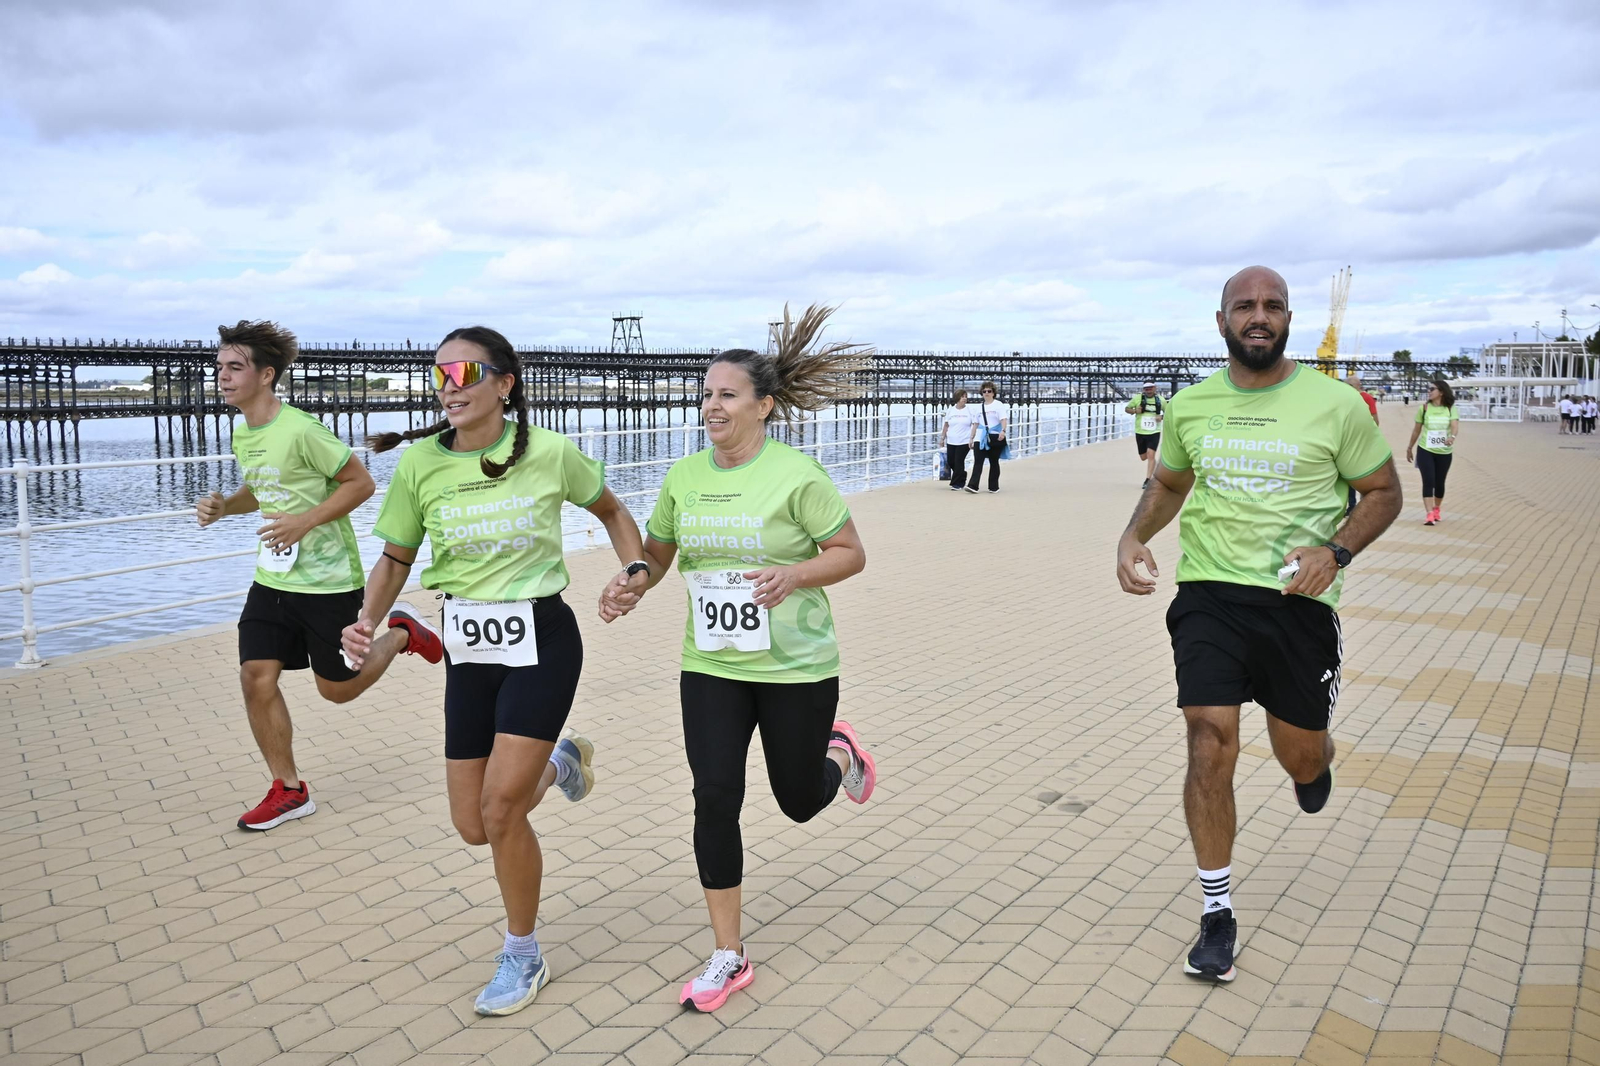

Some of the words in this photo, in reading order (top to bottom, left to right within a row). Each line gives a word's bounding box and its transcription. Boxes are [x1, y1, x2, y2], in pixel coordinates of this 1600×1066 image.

[1202, 434, 1224, 449] En
[1227, 438, 1300, 457] marcha
[1201, 454, 1271, 473] contra
[1273, 459, 1296, 476] el
[1206, 470, 1294, 493] cáncer
[441, 505, 462, 520] En
[466, 494, 535, 517] marcha
[443, 519, 513, 541] contra
[515, 511, 536, 530] el
[680, 511, 697, 527] En
[700, 512, 764, 529] marcha
[680, 531, 740, 548] contra
[742, 532, 765, 550] el
